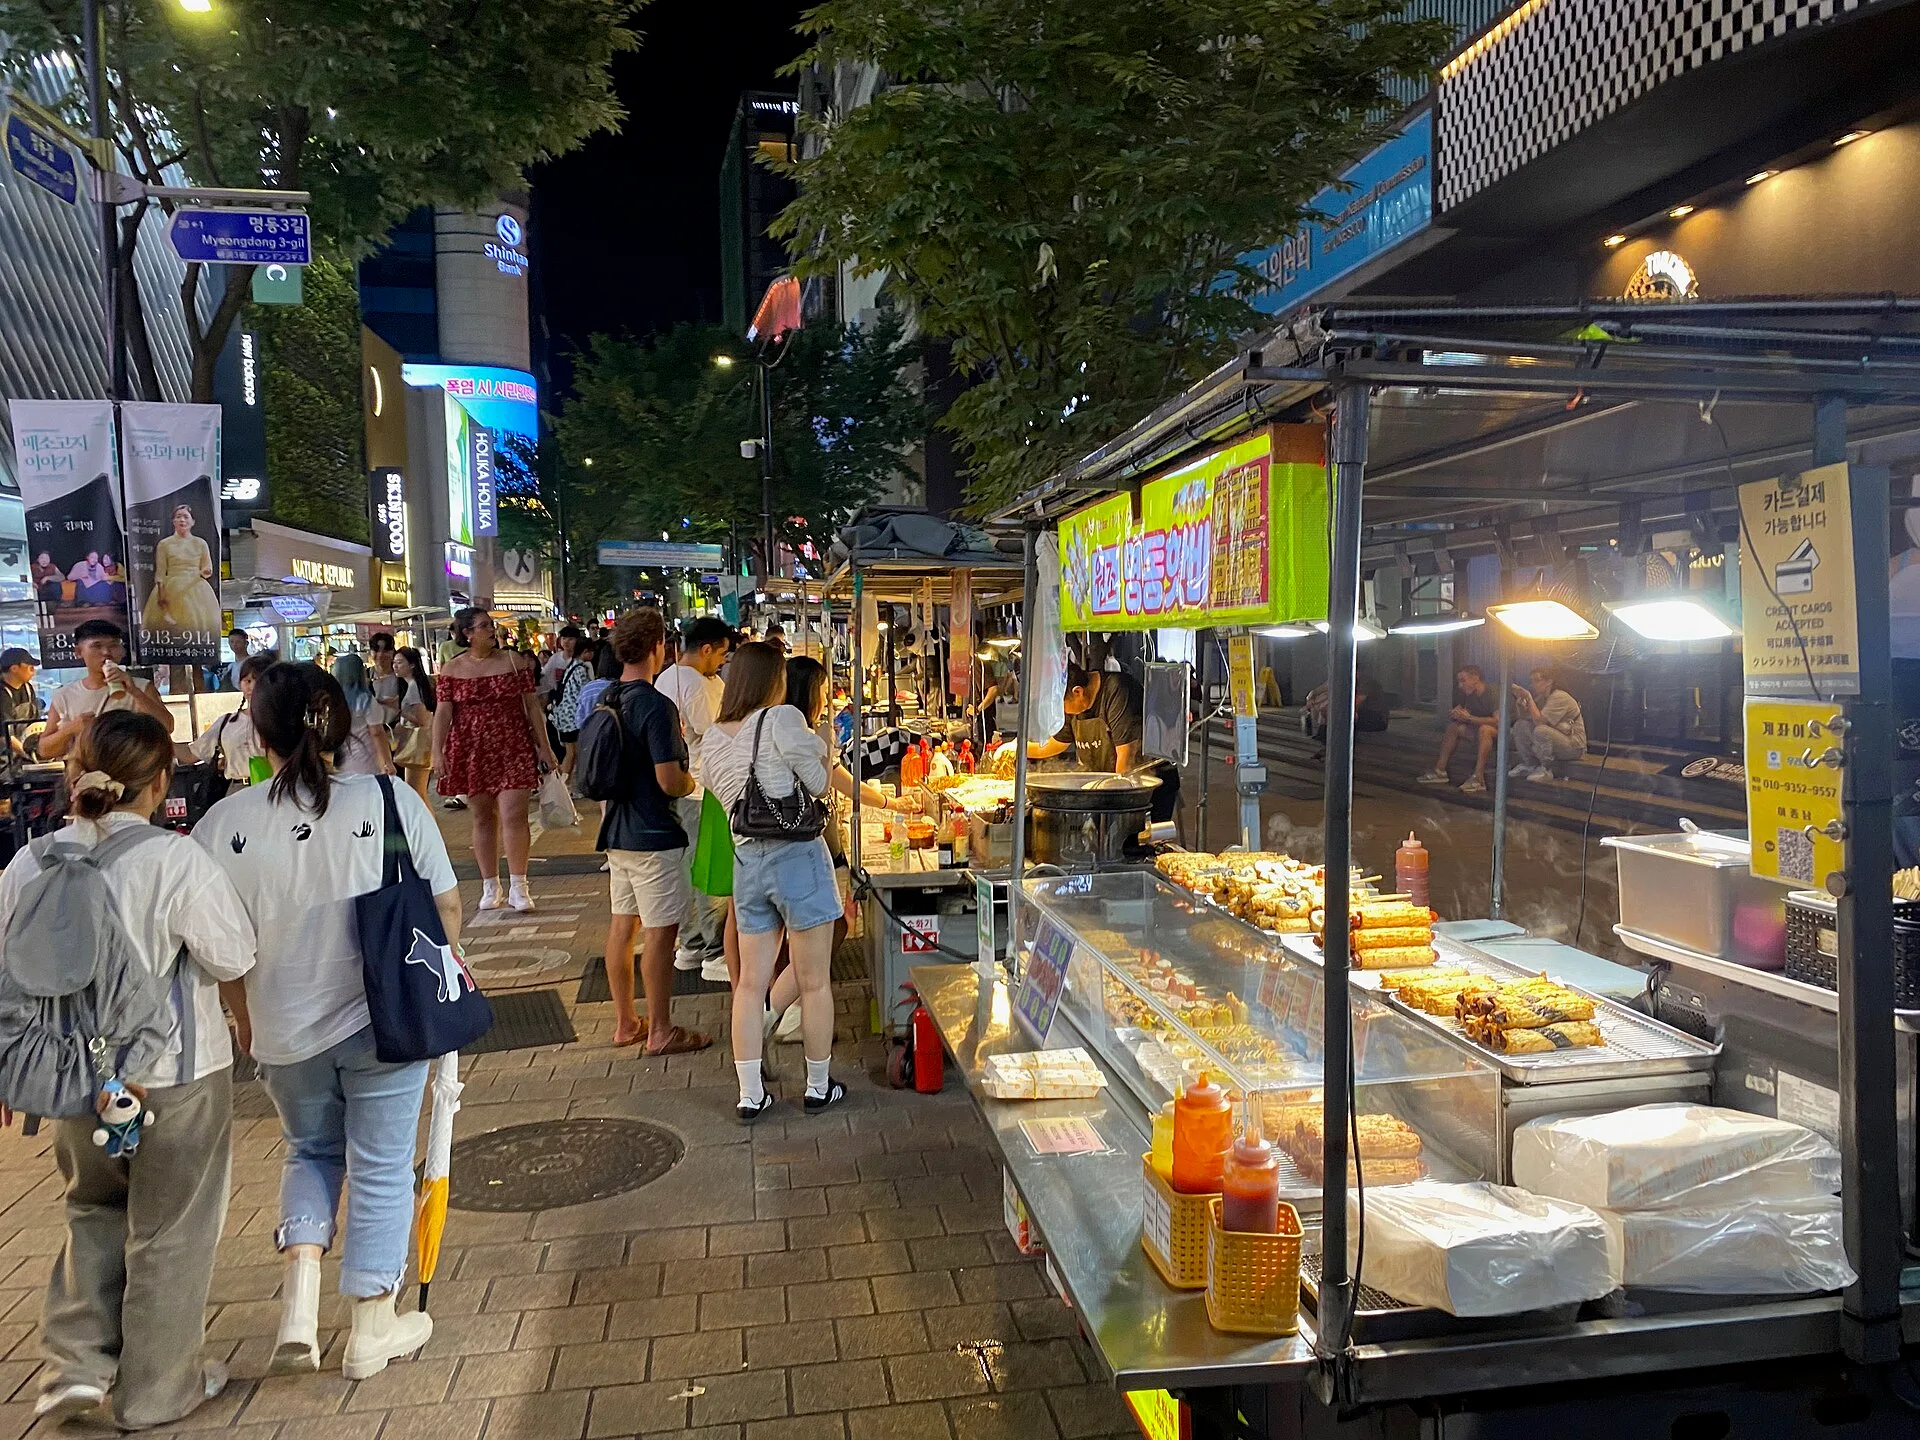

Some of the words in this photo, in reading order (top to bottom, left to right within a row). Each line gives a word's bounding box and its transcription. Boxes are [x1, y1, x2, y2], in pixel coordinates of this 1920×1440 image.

[248, 215, 304, 235] 명동3길
[201, 234, 276, 249] Myeongdong
[278, 237, 305, 250] 3-gil
[496, 260, 522, 277] Bank
[241, 334, 253, 359] new
[243, 358, 256, 406] balance
[445, 378, 475, 397] 폭염
[477, 378, 492, 397] 시
[22, 434, 88, 453] 배소고지
[176, 445, 207, 461] 바다
[26, 453, 74, 471] 이야기
[475, 432, 490, 480] HOLIKA
[477, 482, 492, 530] HOLIKA
[1763, 481, 1826, 513] 카드결제
[386, 473, 404, 555] SKINFOOD
[1764, 510, 1827, 535] 가능합니다
[291, 558, 324, 585] NATURE
[323, 563, 355, 588] REPUBLIC
[1800, 601, 1833, 613] CARDS
[1775, 617, 1825, 632] ACCEPTED
[907, 919, 933, 930] 소화기
